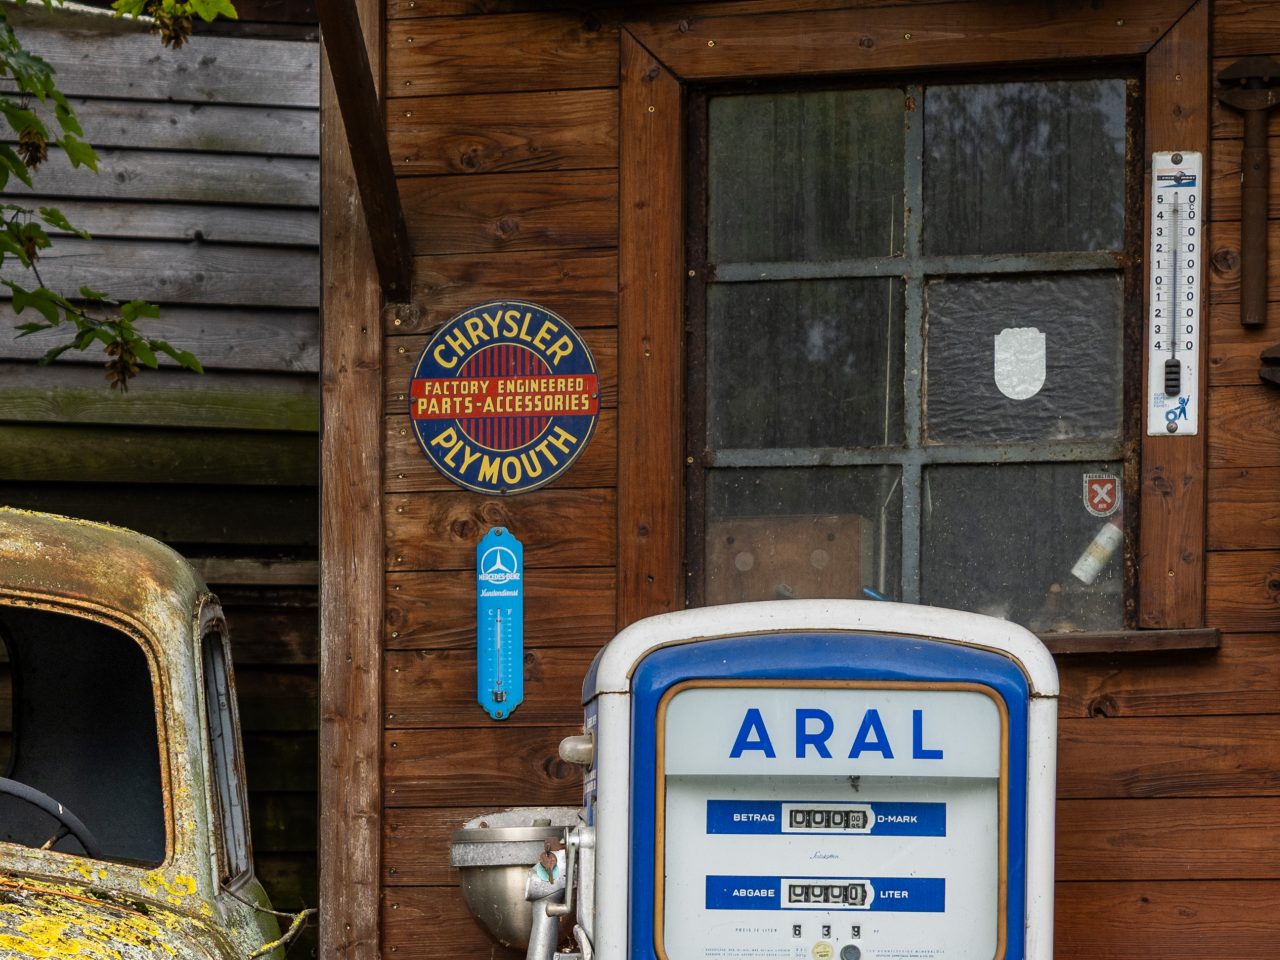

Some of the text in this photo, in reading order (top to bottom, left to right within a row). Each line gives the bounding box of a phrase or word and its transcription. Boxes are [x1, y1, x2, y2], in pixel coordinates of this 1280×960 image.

[433, 310, 574, 369] CHRYSLER
[425, 377, 584, 396] FACTORY ENGINEERED
[417, 393, 590, 415] PARTS-ACCESSORIES
[430, 425, 578, 485] PLYMOUTH
[729, 708, 944, 760] ARAL
[733, 812, 775, 822] BETRAG
[877, 815, 918, 824] D-MARK
[732, 888, 775, 898] ABGABE
[880, 890, 909, 899] LITER
